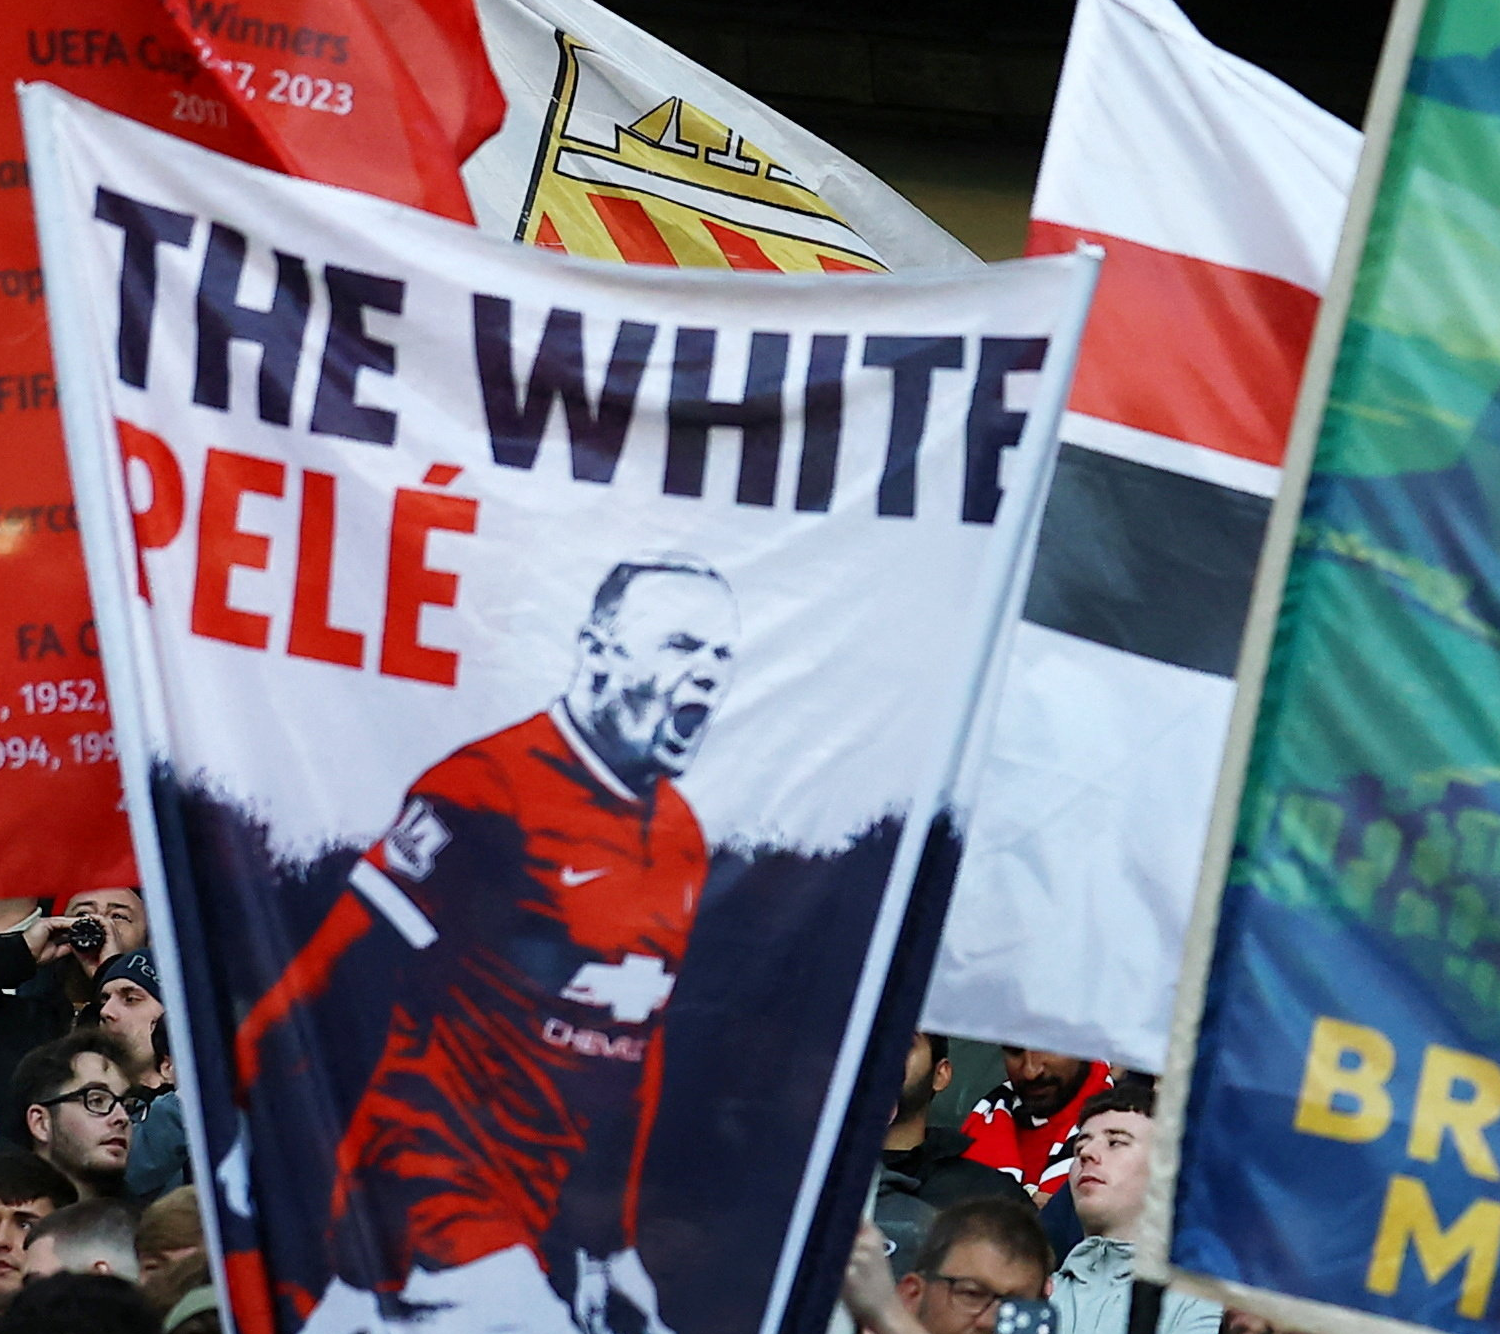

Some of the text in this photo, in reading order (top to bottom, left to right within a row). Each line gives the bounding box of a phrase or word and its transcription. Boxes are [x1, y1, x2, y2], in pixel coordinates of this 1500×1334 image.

[27, 28, 130, 67] UEFA
[267, 68, 355, 116] 2023
[93, 185, 1052, 527] THE WHITE
[111, 415, 481, 688] PELÉ
[17, 623, 67, 662] FA
[18, 678, 106, 715] 1952,
[69, 729, 121, 764] 199
